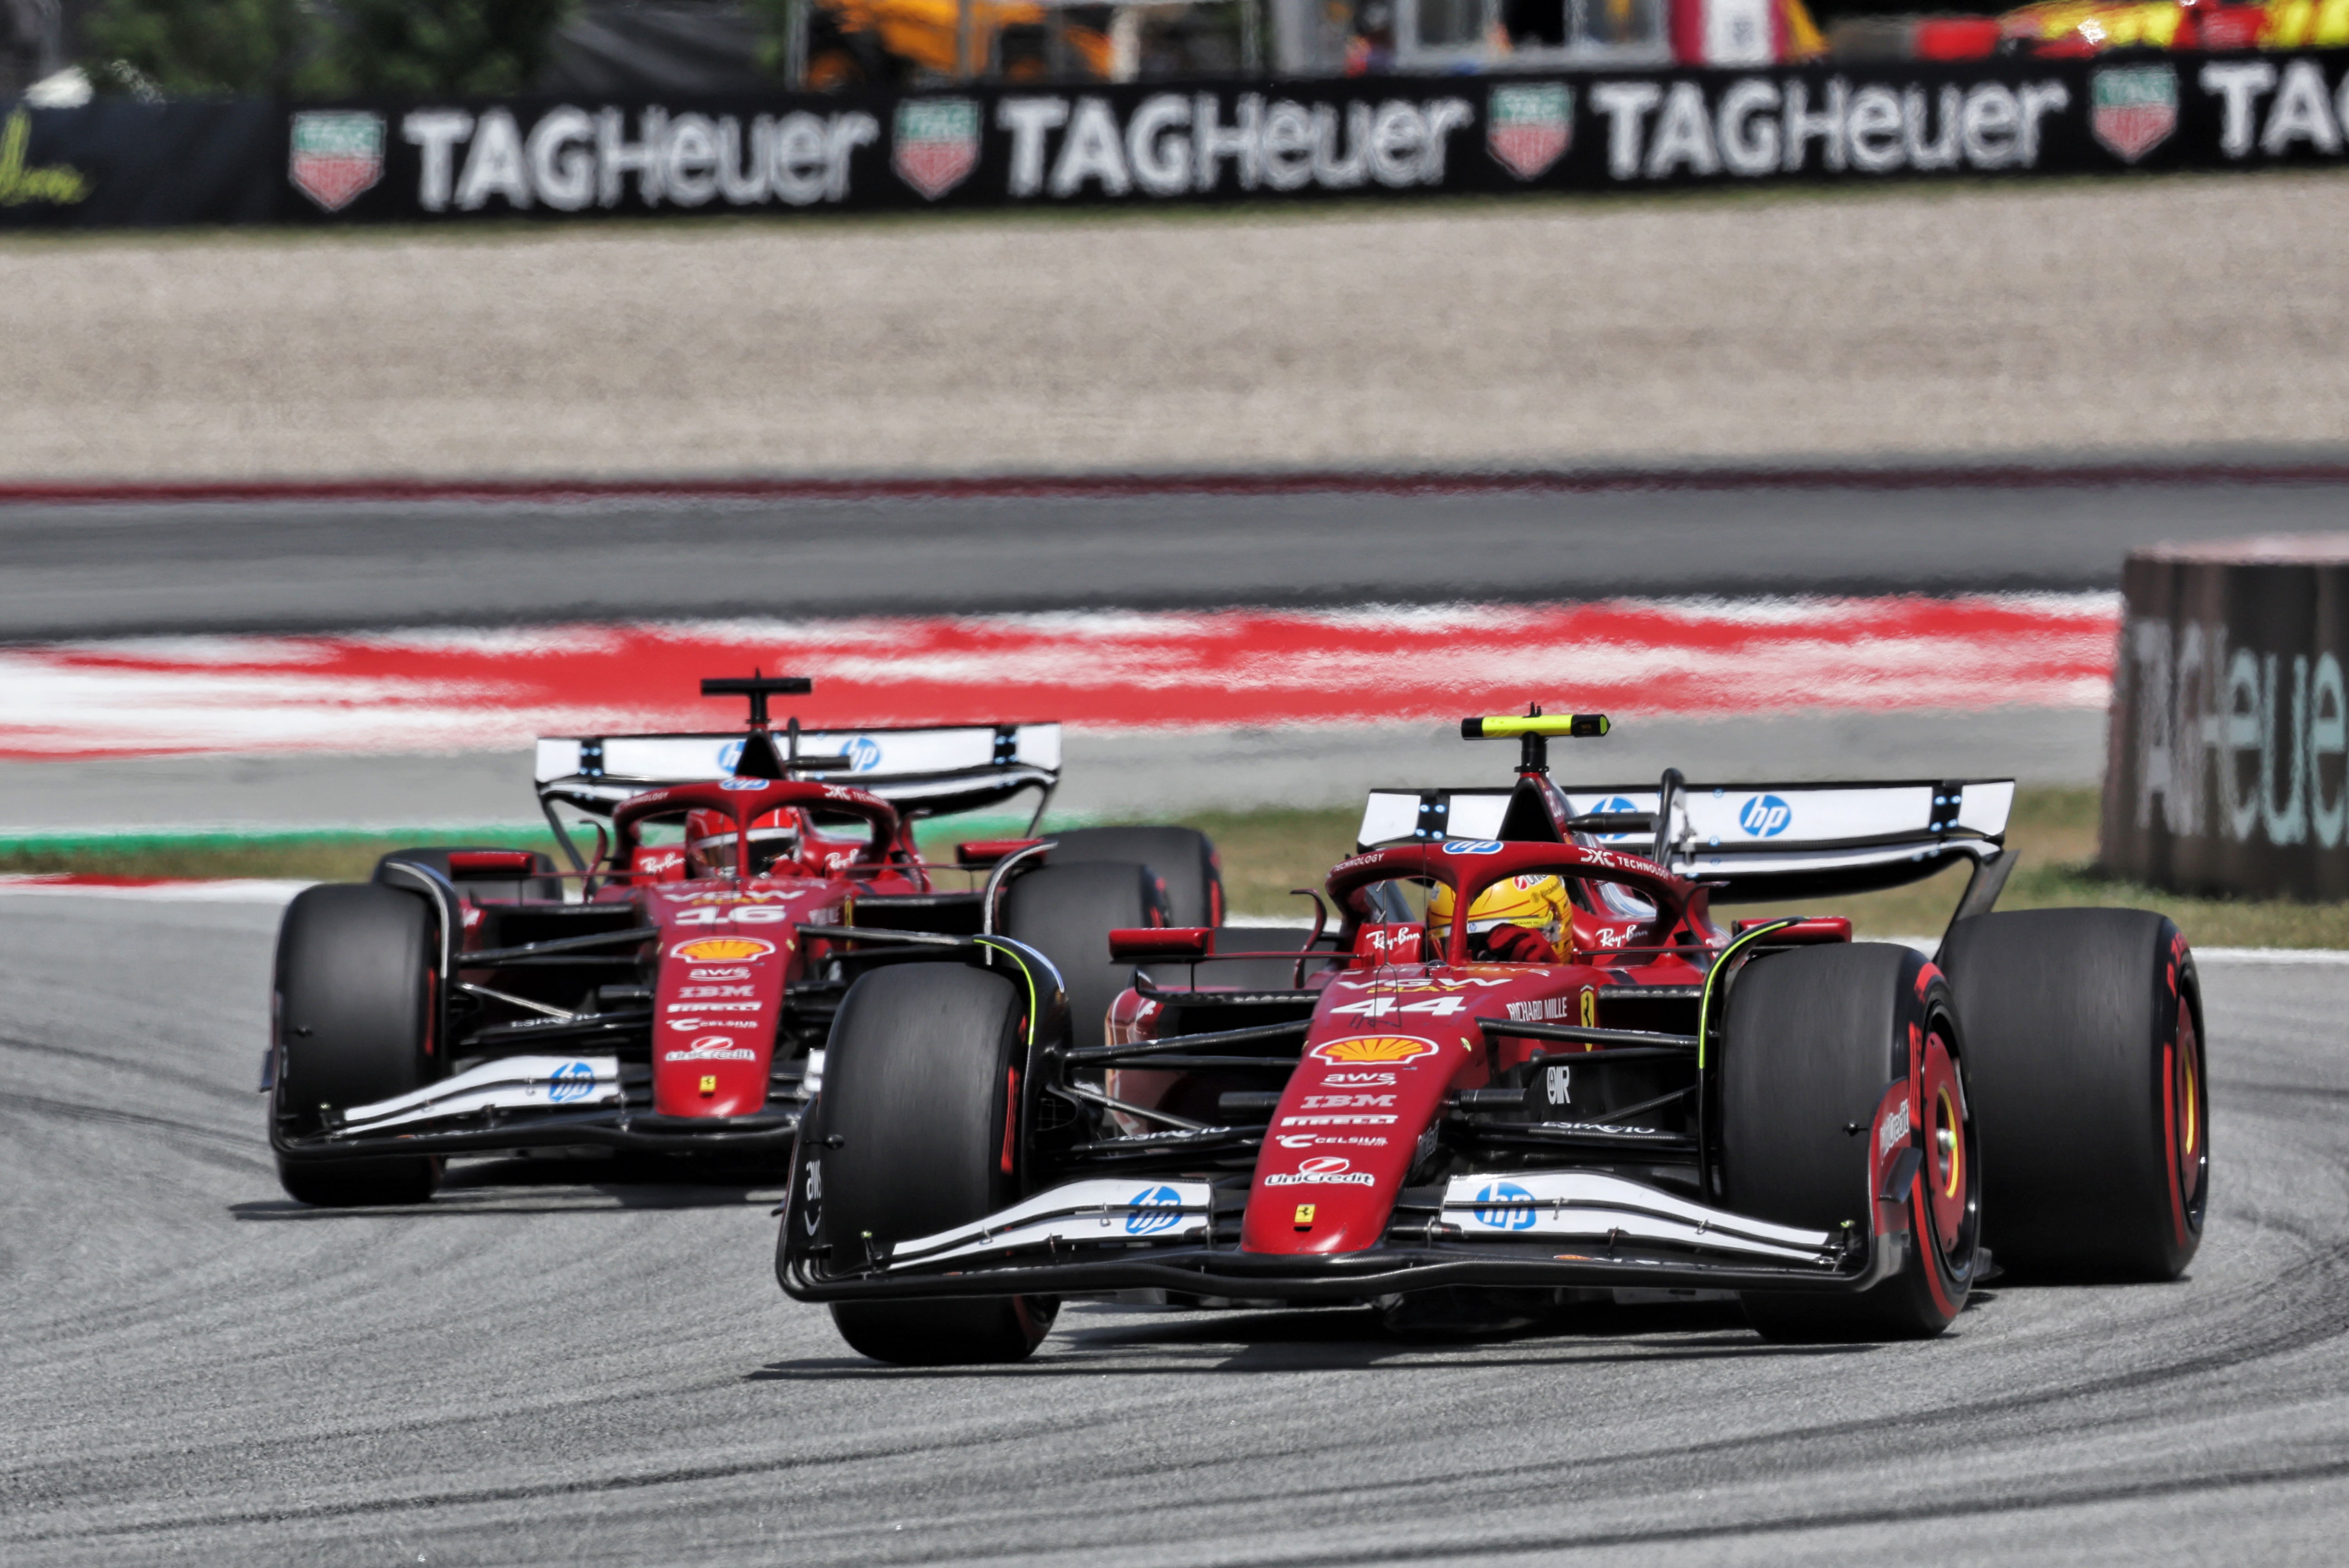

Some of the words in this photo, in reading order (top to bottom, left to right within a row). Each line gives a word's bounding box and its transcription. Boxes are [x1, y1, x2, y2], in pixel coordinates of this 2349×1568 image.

[2201, 60, 2349, 156] TA
[1742, 793, 1789, 838] hp
[1449, 840, 1498, 853] hp
[1578, 847, 1615, 868] DXC
[1616, 856, 1669, 879] TECHNOLOGY
[674, 905, 786, 925] 16
[1365, 927, 1421, 950] Ray-Ban
[690, 967, 750, 977] aws
[679, 985, 755, 998] IBM
[1337, 978, 1513, 989] VGW
[1366, 985, 1466, 994] PLAY
[1330, 996, 1466, 1017] 44
[1506, 999, 1543, 1022] RICHARD
[1544, 997, 1568, 1019] MILLE
[1324, 1072, 1396, 1083] aws
[1300, 1094, 1397, 1109] IBM
[1280, 1115, 1399, 1127] PIRELLI
[1266, 1172, 1373, 1186] UniCredit
[1128, 1186, 1179, 1235] hp
[1478, 1182, 1534, 1231] hp
